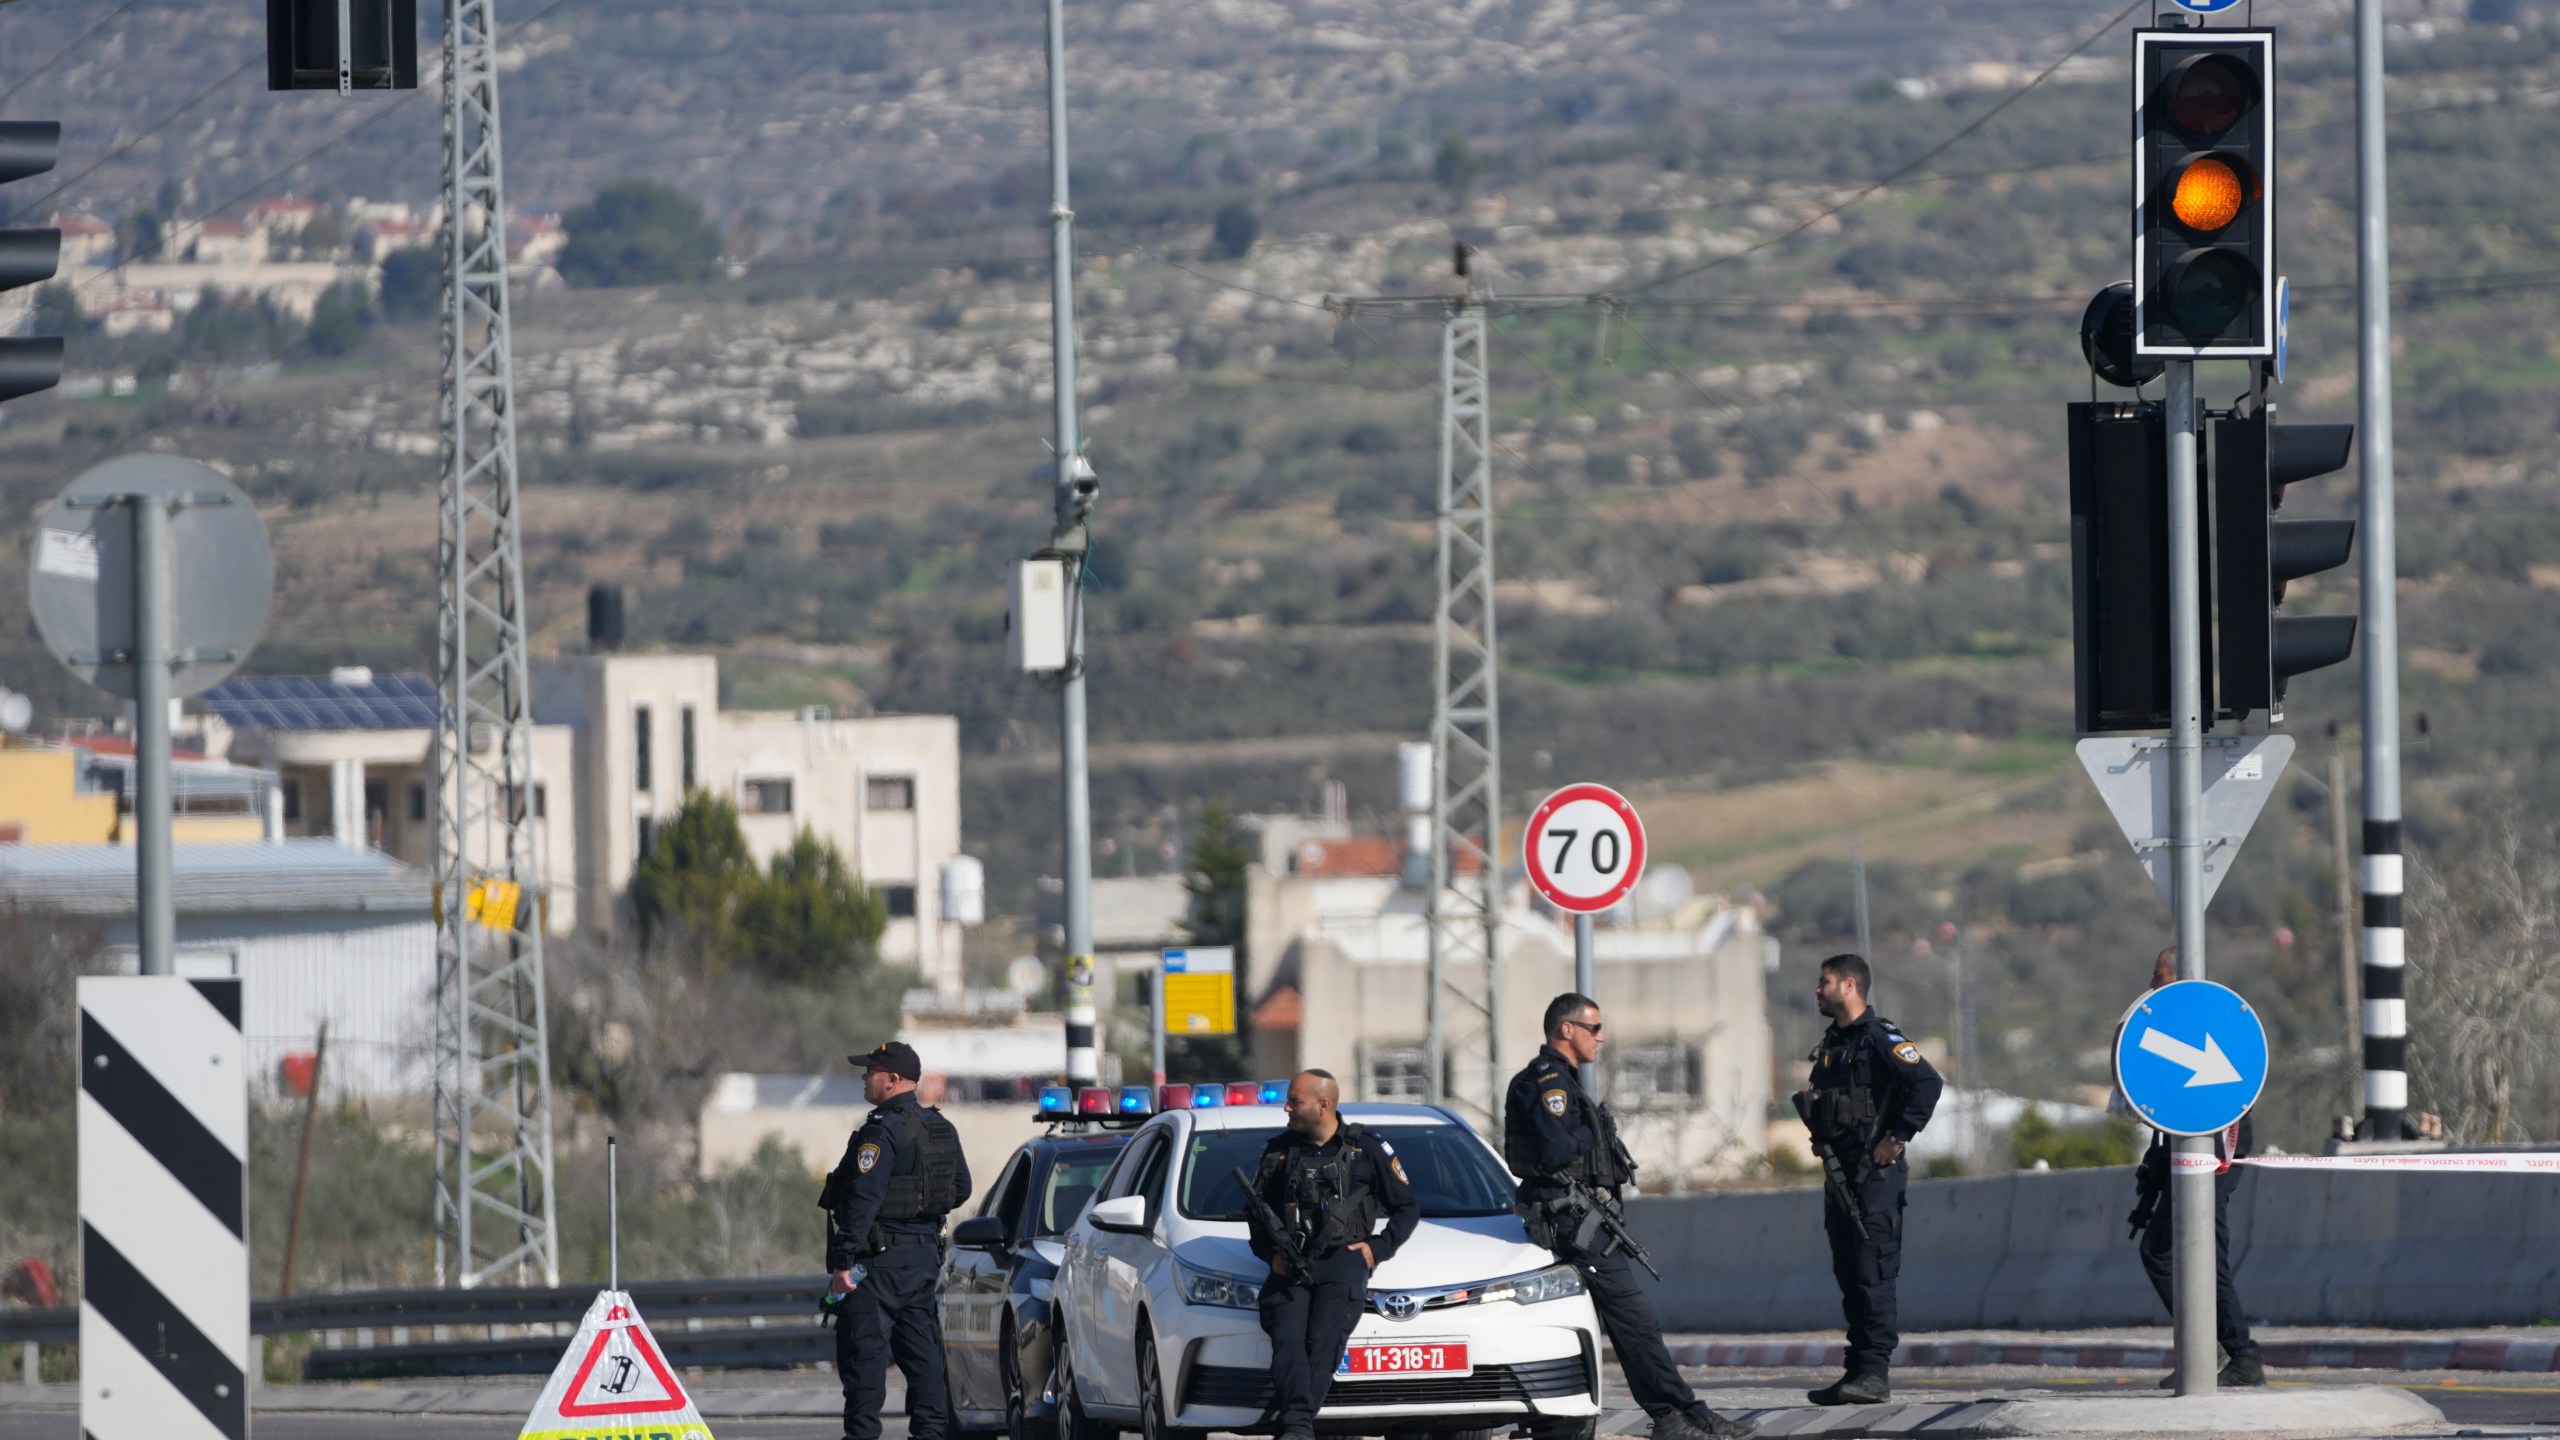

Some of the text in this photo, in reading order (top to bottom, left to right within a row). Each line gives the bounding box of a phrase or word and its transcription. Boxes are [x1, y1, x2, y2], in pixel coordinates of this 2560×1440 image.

[1548, 829, 1620, 874] 70
[2423, 1158, 2507, 1167] משטרת התנועה
[1364, 1347, 1444, 1370] 11-318-מ
